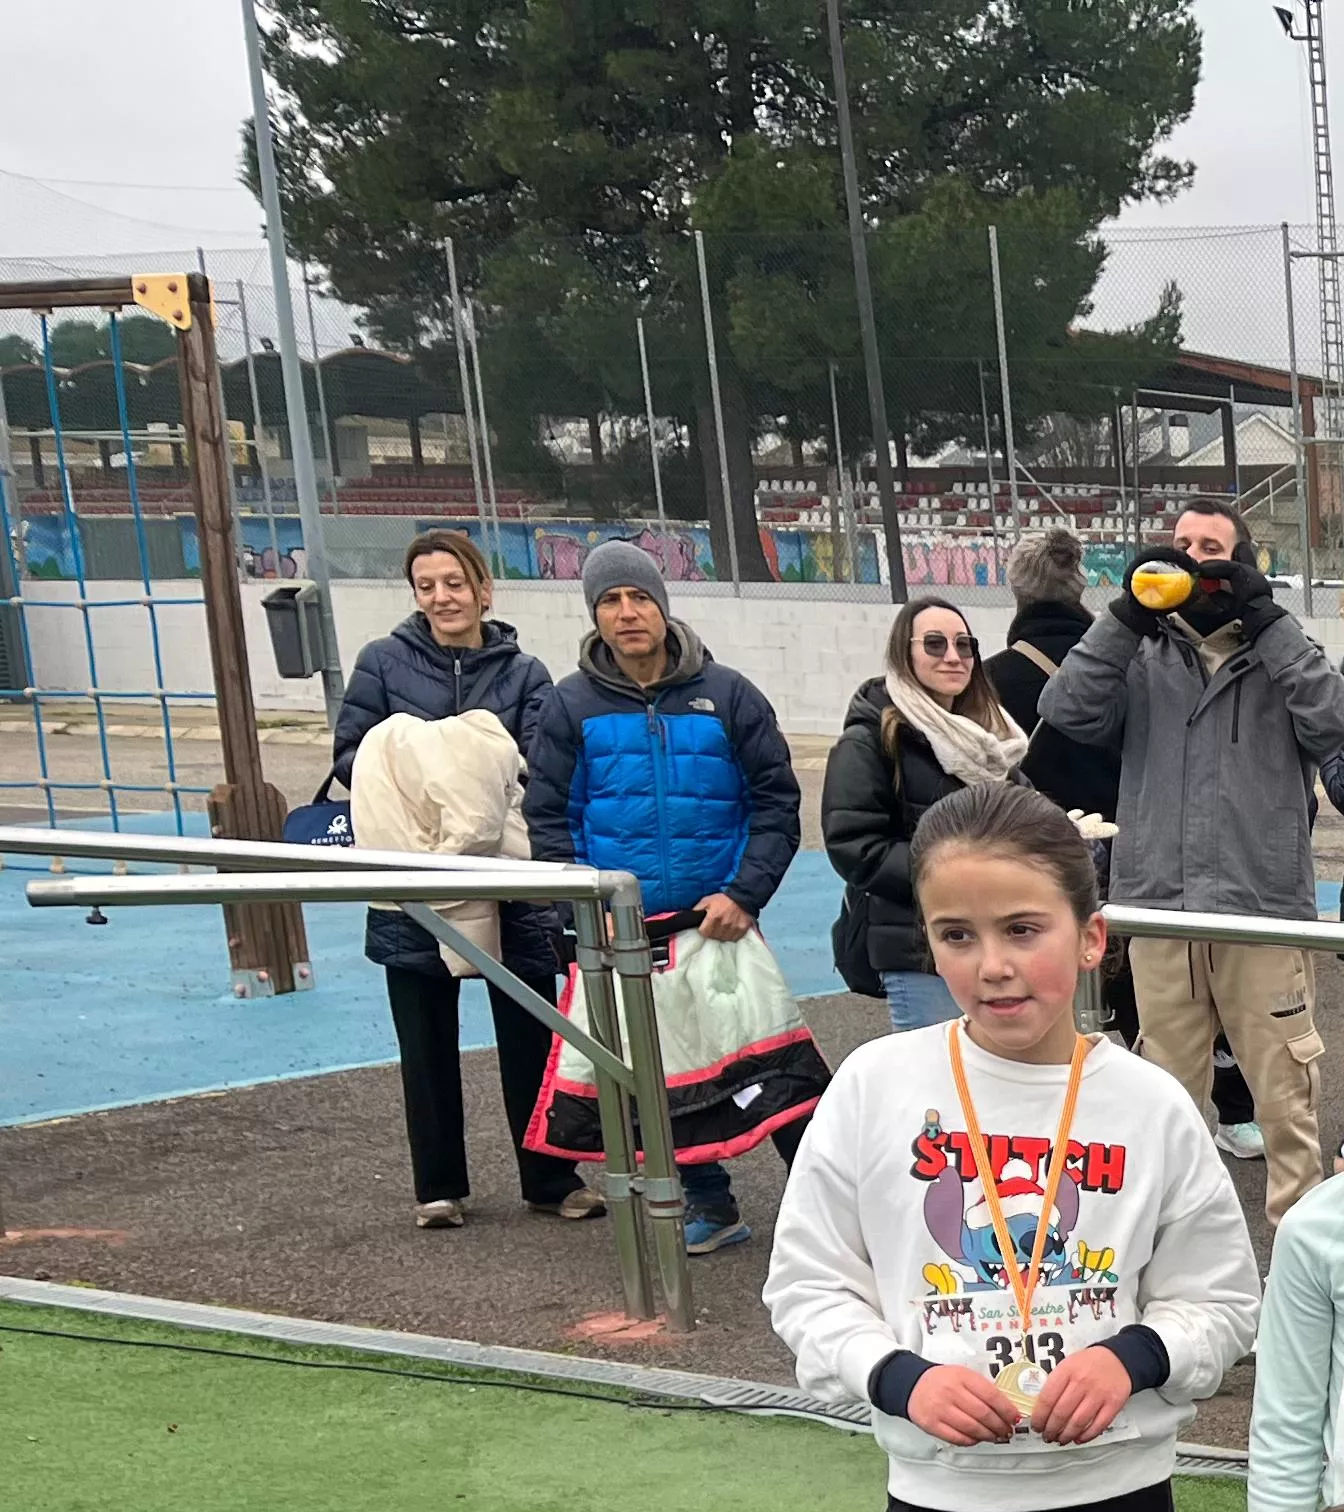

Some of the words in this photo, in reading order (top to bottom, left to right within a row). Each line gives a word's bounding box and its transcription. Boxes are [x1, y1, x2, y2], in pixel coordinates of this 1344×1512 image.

[311, 835, 353, 844] BENETTO
[978, 1306, 1004, 1320] San
[985, 1332, 1066, 1379] 313
